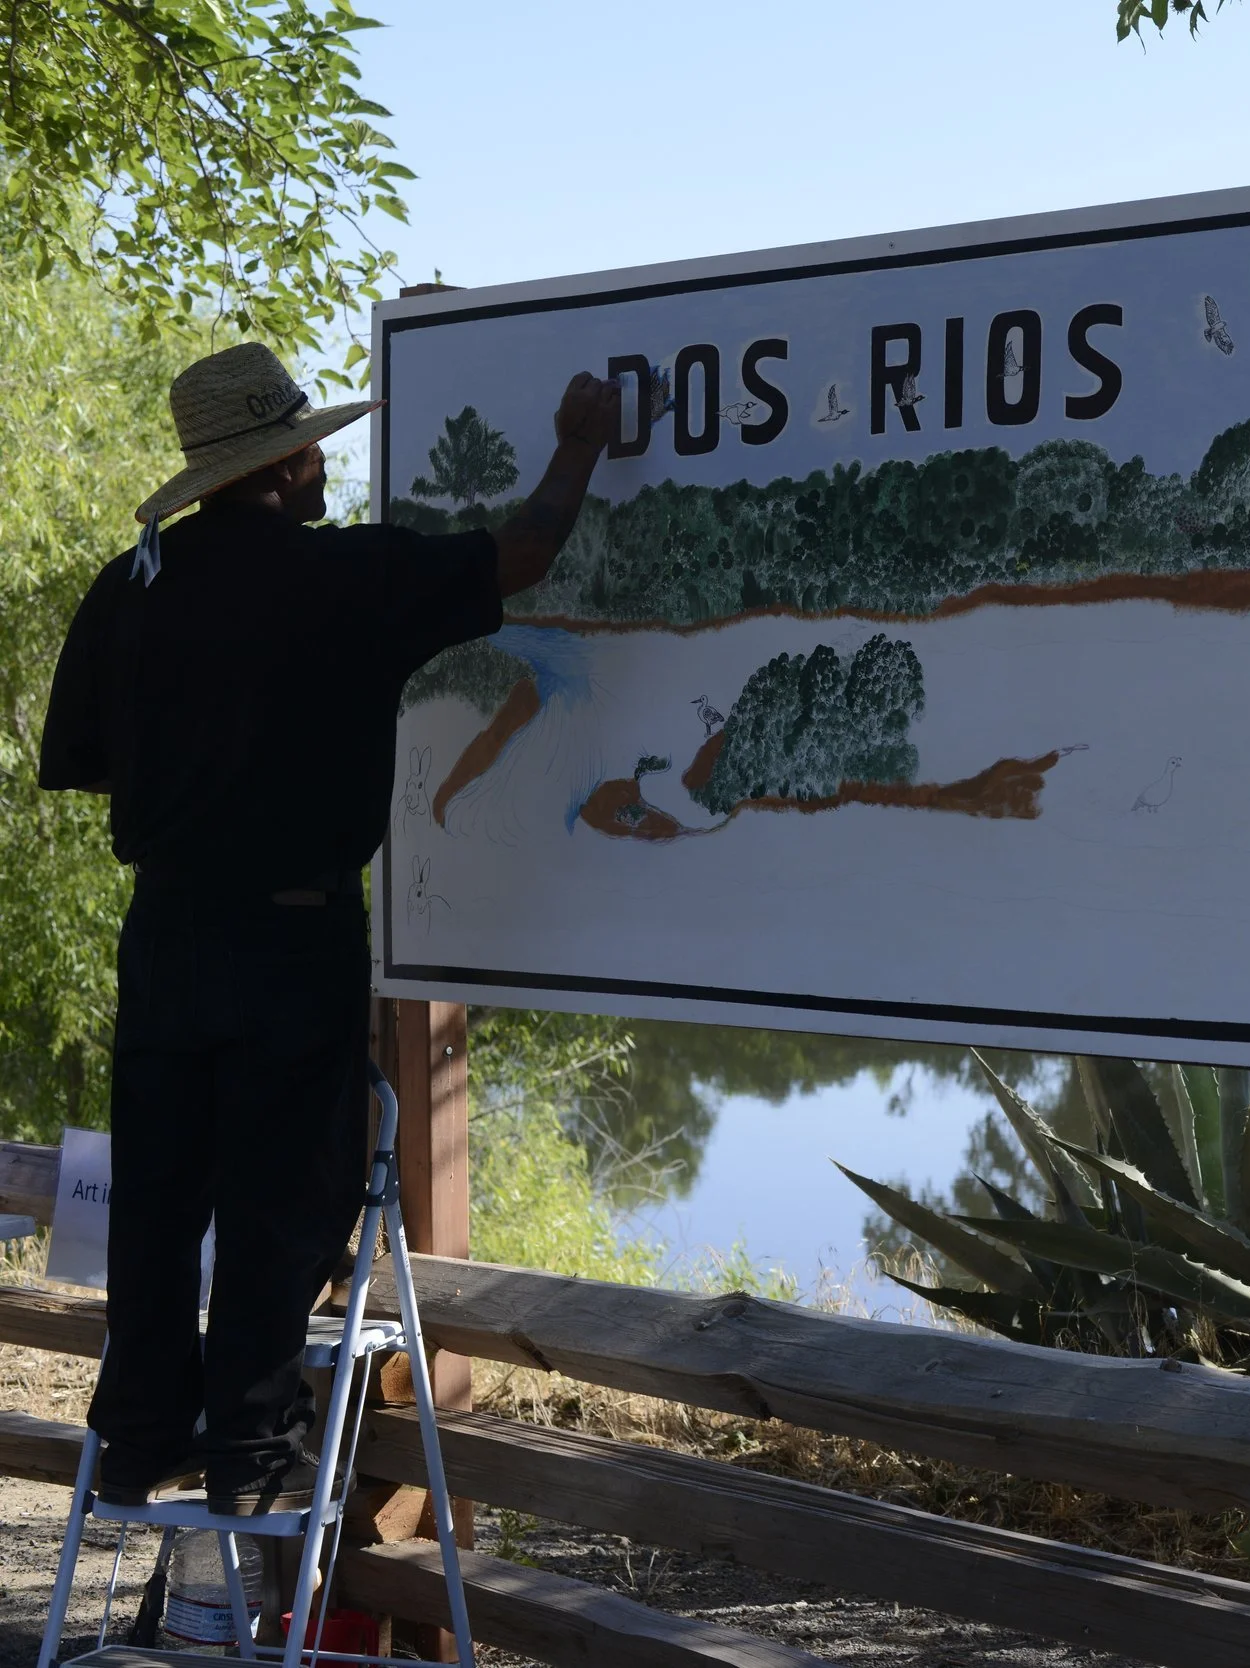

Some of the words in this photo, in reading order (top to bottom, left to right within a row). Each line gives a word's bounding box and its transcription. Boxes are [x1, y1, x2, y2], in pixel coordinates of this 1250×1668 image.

[607, 339, 789, 460] DOS
[869, 303, 1123, 435] RIOS
[72, 1179, 98, 1202] Art
